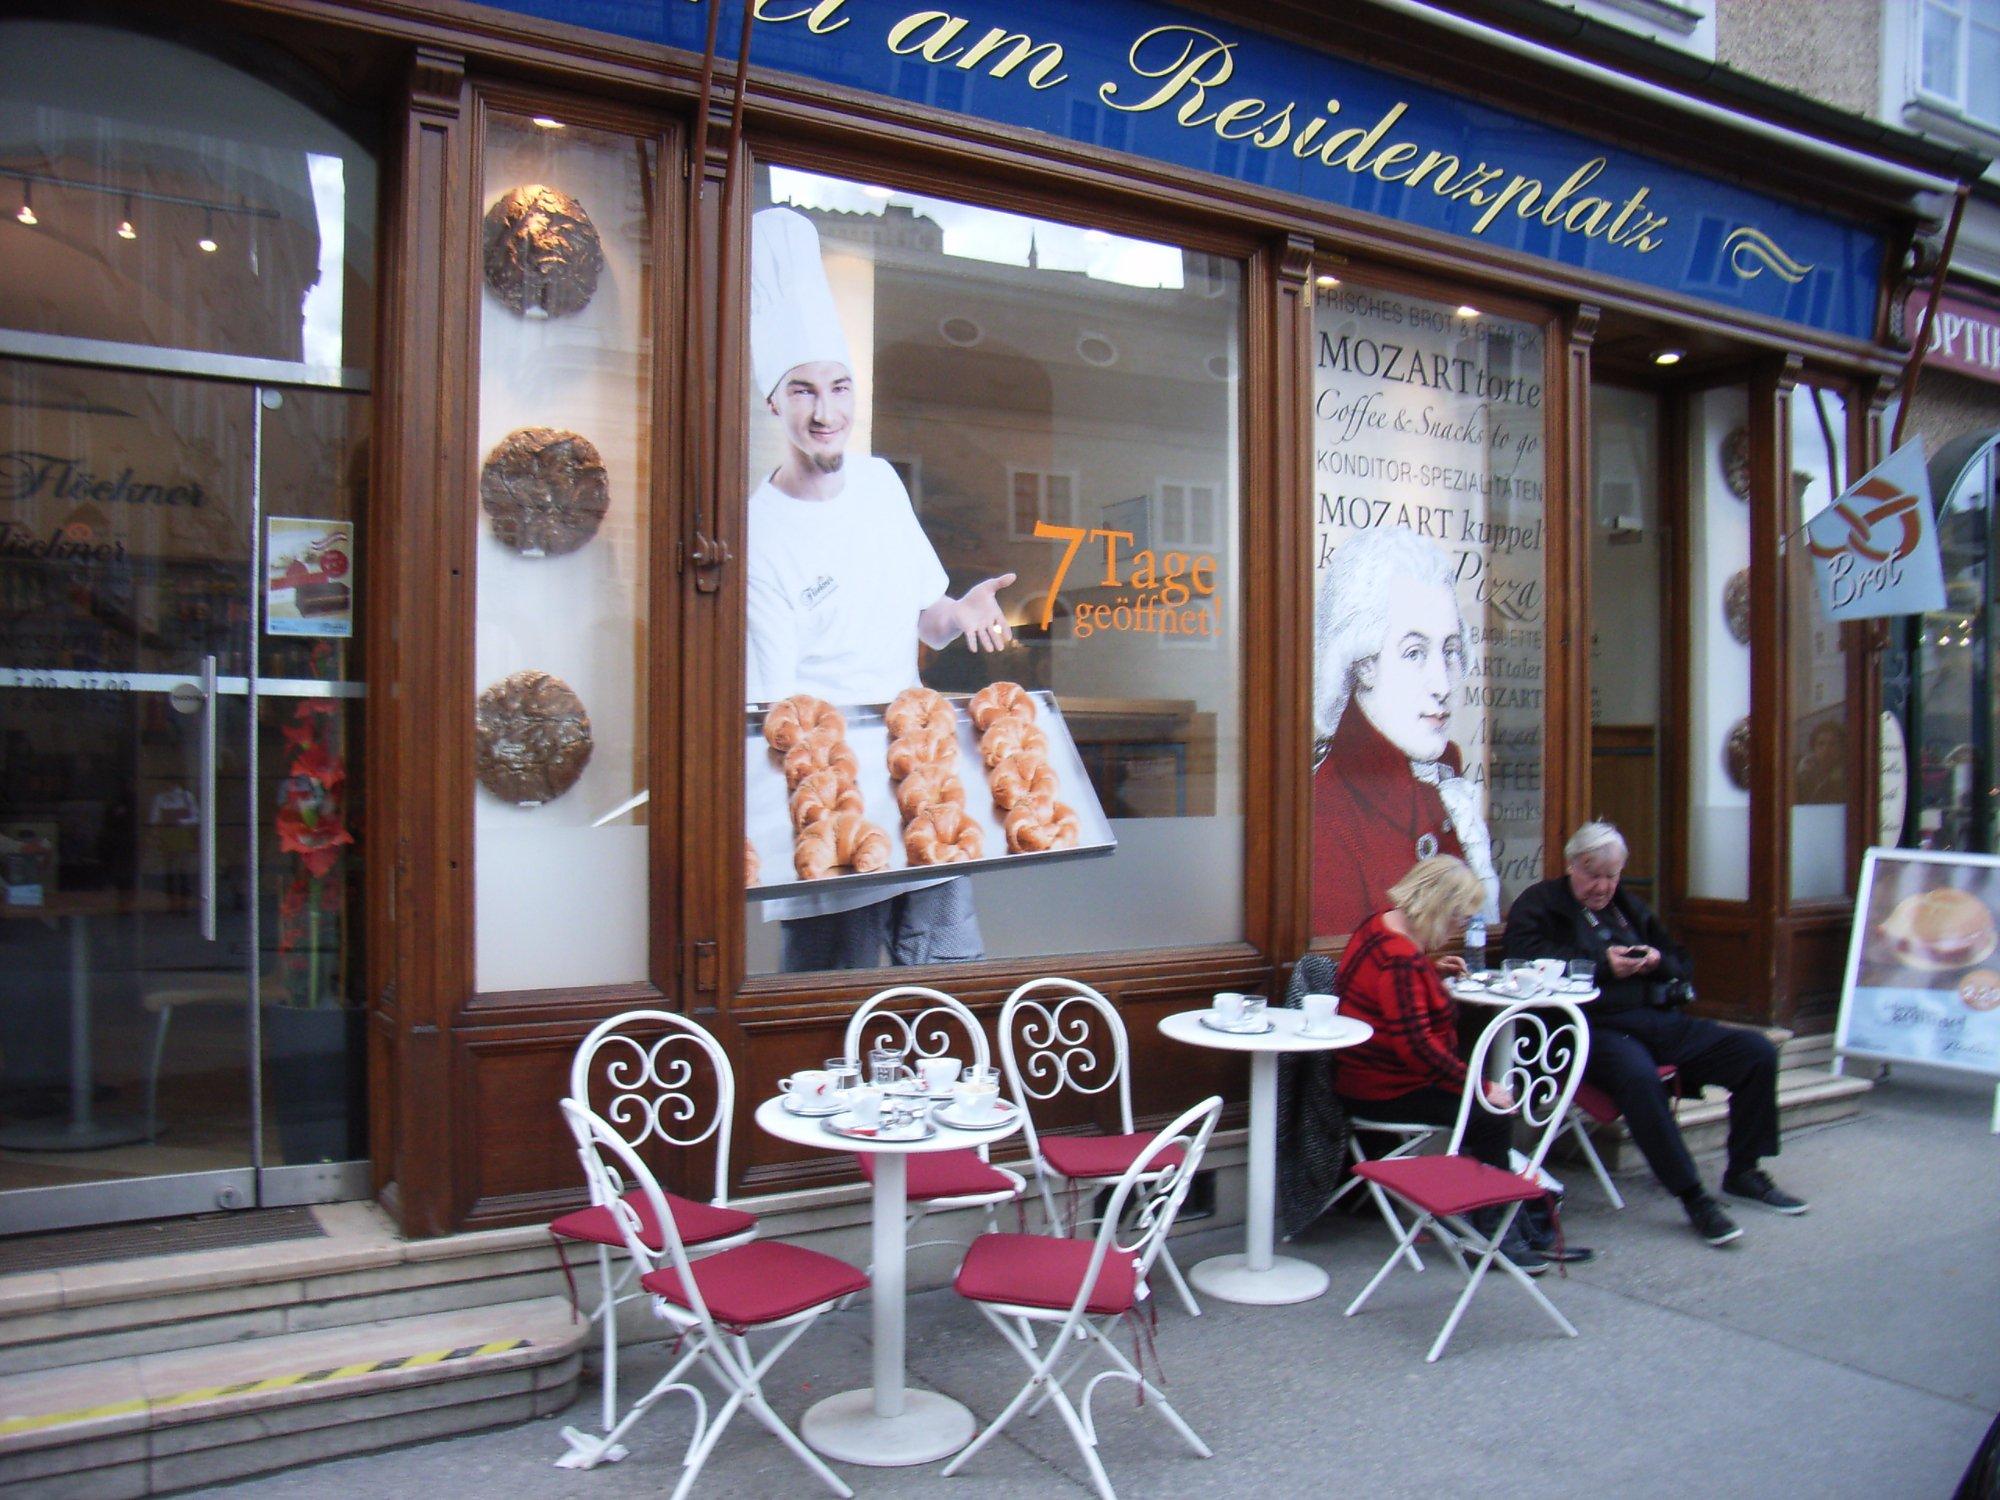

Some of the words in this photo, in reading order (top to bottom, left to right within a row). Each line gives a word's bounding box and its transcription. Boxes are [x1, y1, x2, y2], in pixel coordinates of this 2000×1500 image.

[888, 11, 1069, 89] am
[1099, 25, 1669, 252] Residenzplatz
[1316, 388, 1388, 446] Coffee
[1394, 409, 1413, 433] &
[1415, 404, 1484, 447] Snacks
[1492, 424, 1511, 449] to
[1512, 436, 1538, 473] go
[1033, 520, 1087, 631] 7
[1087, 528, 1218, 607] Tage
[1452, 550, 1542, 622] Pizza
[1827, 545, 1905, 610] Brot
[1073, 593, 1223, 638] geöffnet!
[1463, 686, 1542, 709] MOZART
